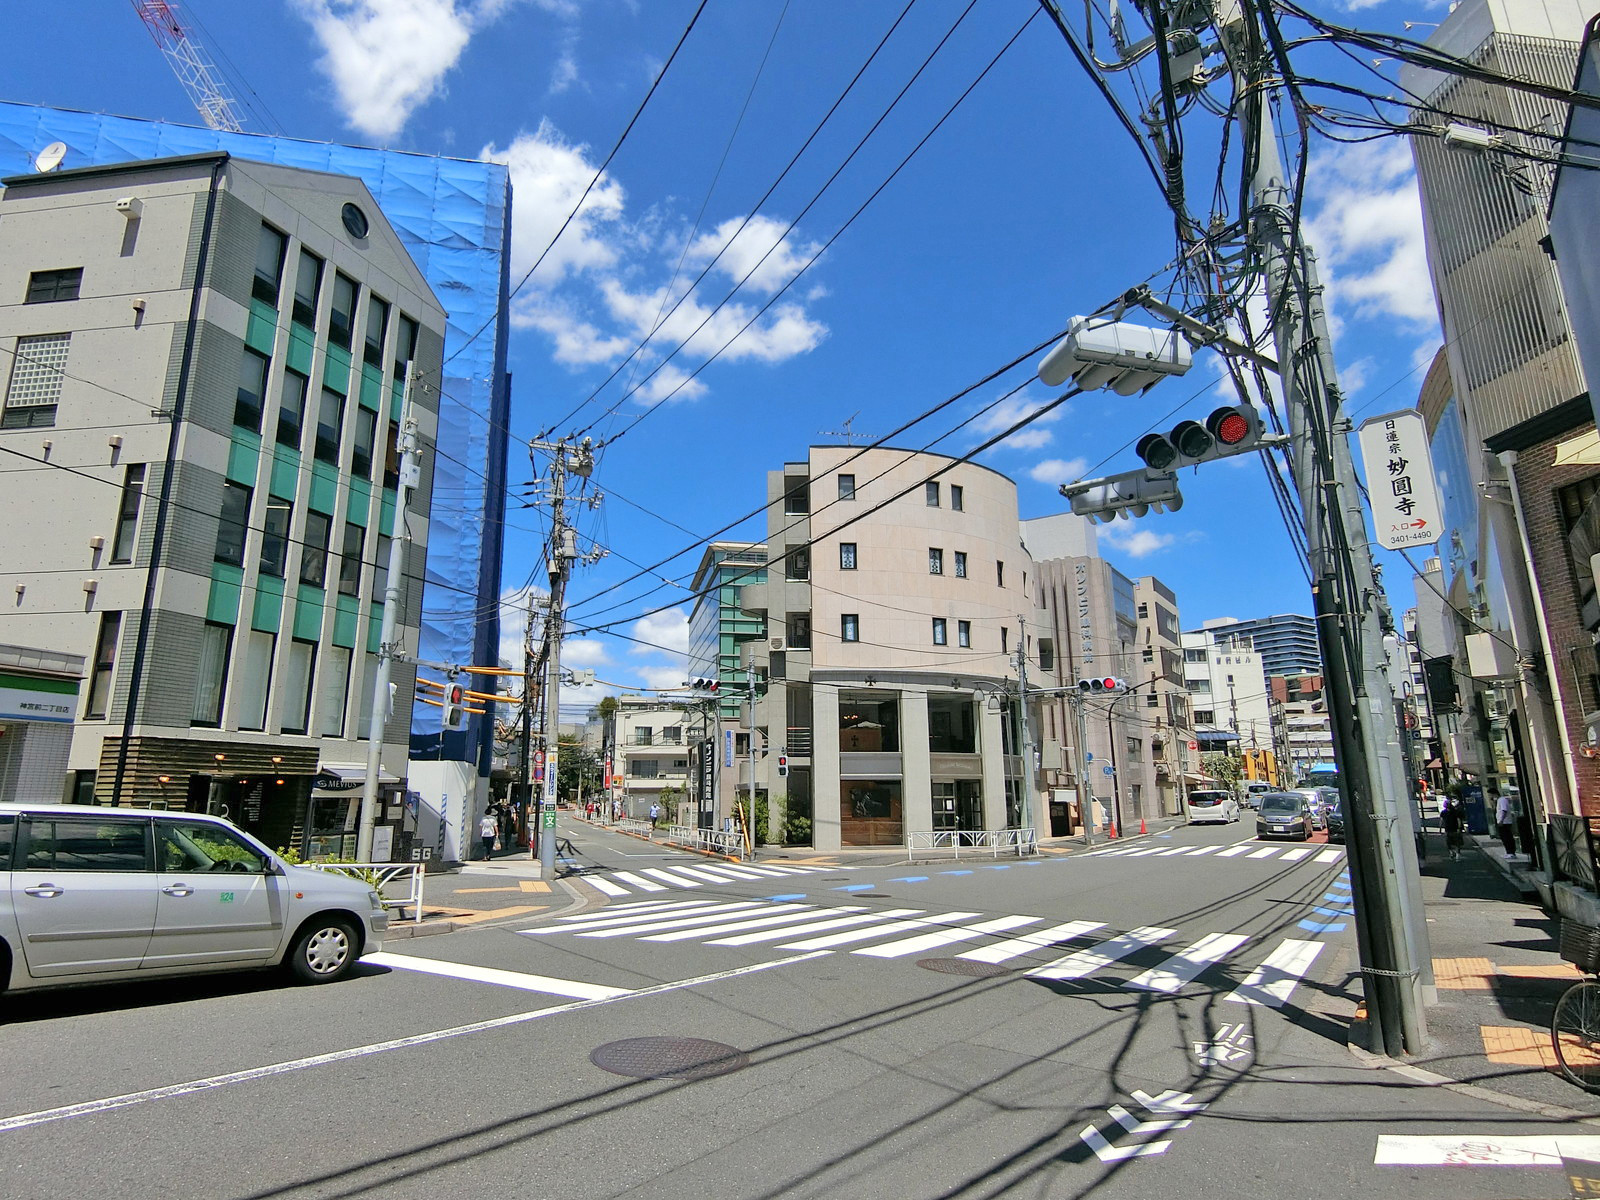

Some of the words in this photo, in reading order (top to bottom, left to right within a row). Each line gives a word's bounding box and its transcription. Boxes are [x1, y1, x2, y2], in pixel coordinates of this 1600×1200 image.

[1385, 420, 1401, 454] 日蓮宗
[1387, 457, 1416, 516] 妙圓寺
[1391, 523, 1409, 532] 入口
[1391, 531, 1432, 544] 3401-4490
[20, 702, 70, 713] 神宮前二丁目店
